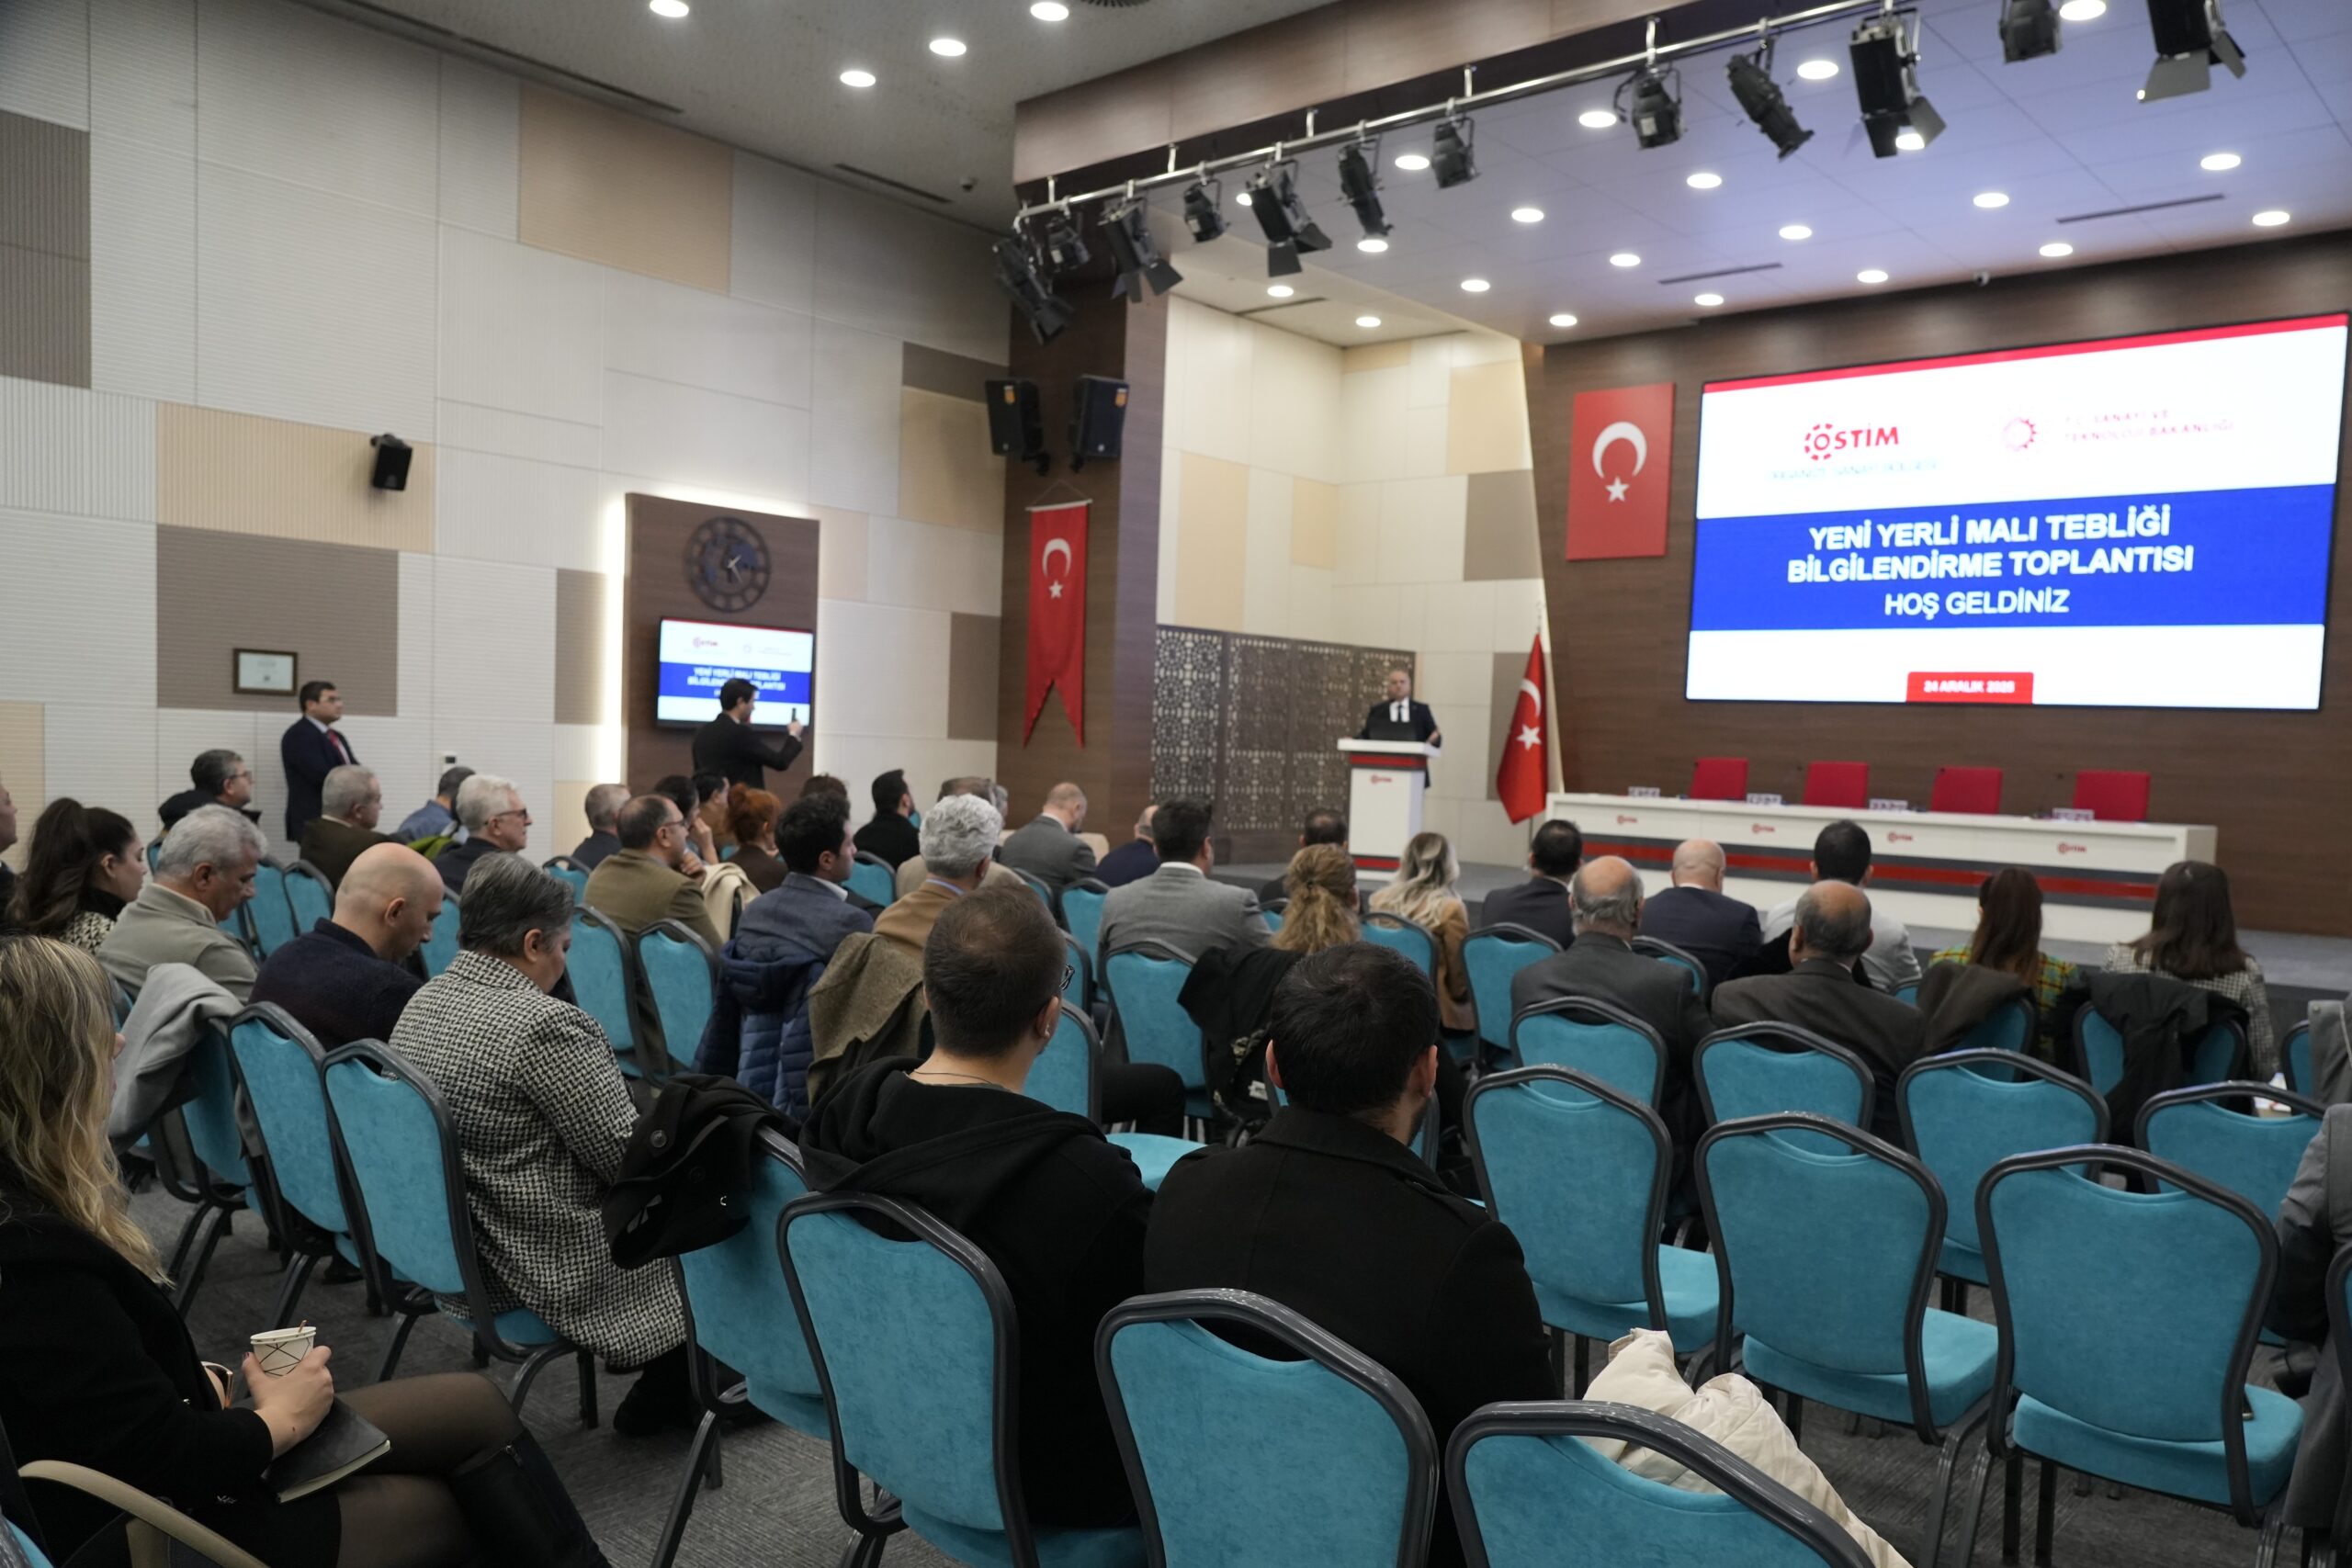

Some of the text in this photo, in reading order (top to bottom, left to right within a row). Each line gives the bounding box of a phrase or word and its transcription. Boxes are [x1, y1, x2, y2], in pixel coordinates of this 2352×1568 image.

[1809, 503, 2171, 550] YENİ YERLİ MALI TEBLİĞİ
[1787, 545, 2195, 583] BİLGİLENDİRME TOPLANTISI
[1884, 586, 2071, 621] HOŞ GELDİNİZ
